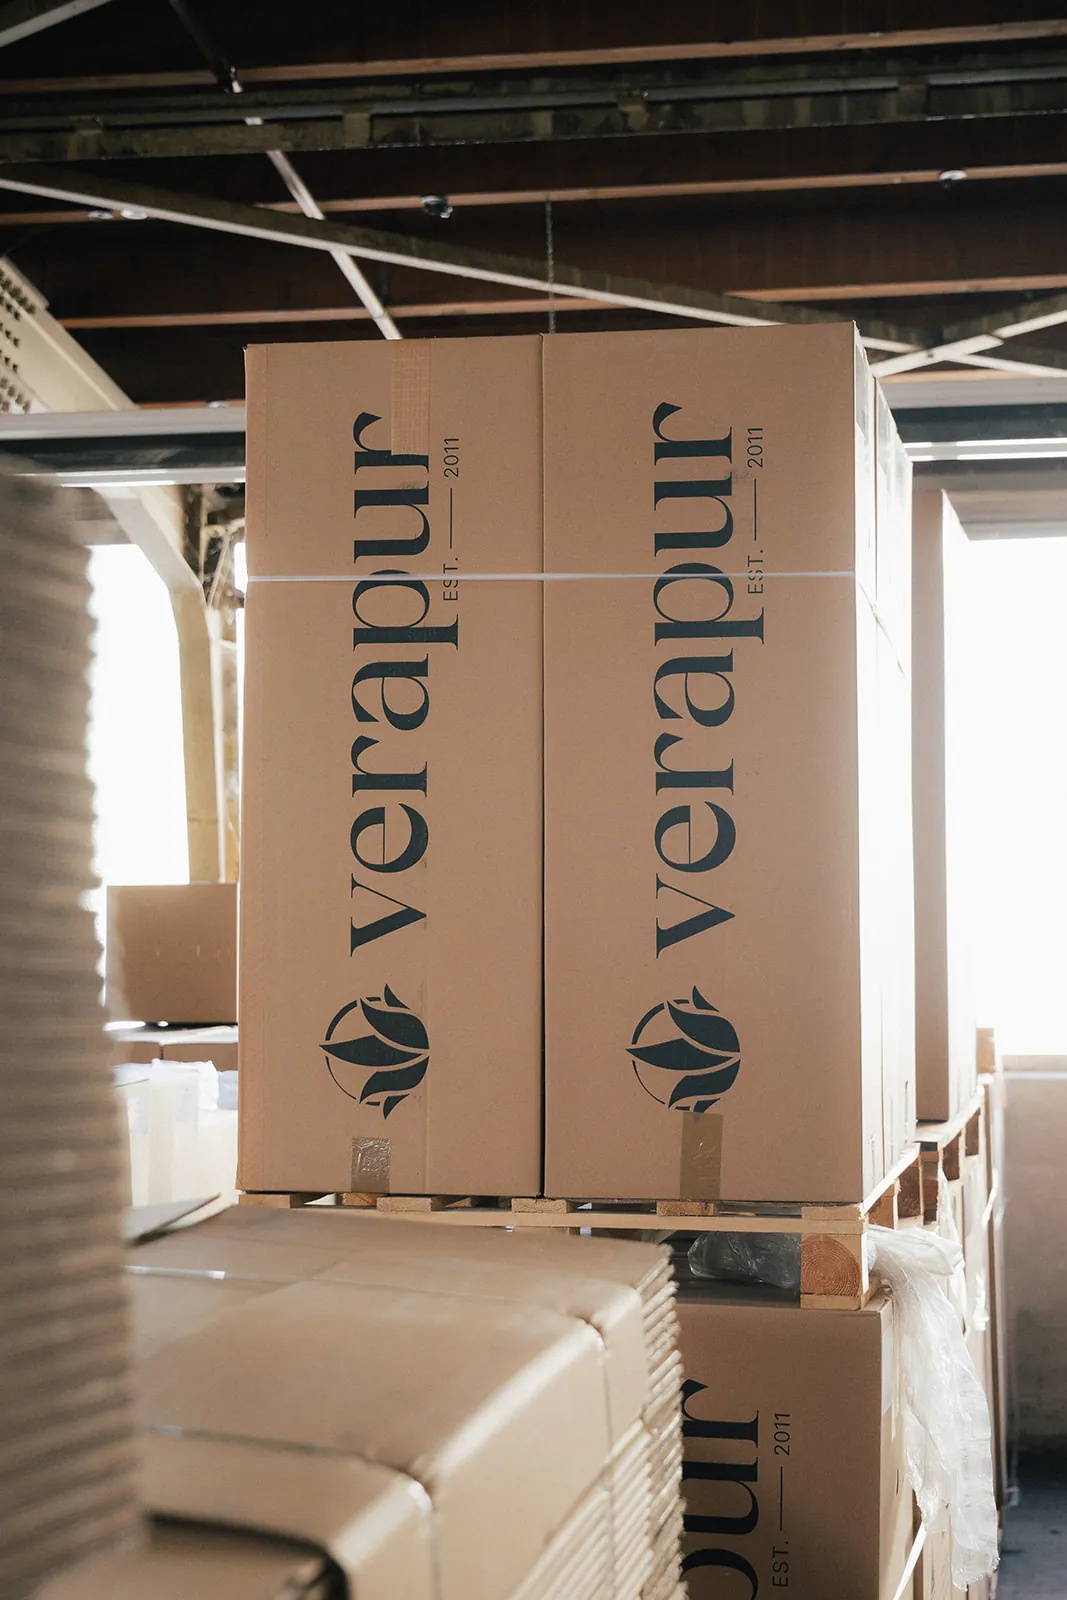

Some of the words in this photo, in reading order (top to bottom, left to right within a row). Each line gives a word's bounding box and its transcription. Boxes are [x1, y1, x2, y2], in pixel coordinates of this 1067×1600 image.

[443, 437, 460, 478] 2011
[746, 427, 764, 469] 2011
[442, 556, 460, 601] EST.
[747, 549, 764, 594] EST.
[350, 411, 459, 958] verapur
[652, 401, 765, 959] verapur
[773, 1412, 791, 1456] 2011
[771, 1540, 789, 1588] EST.
